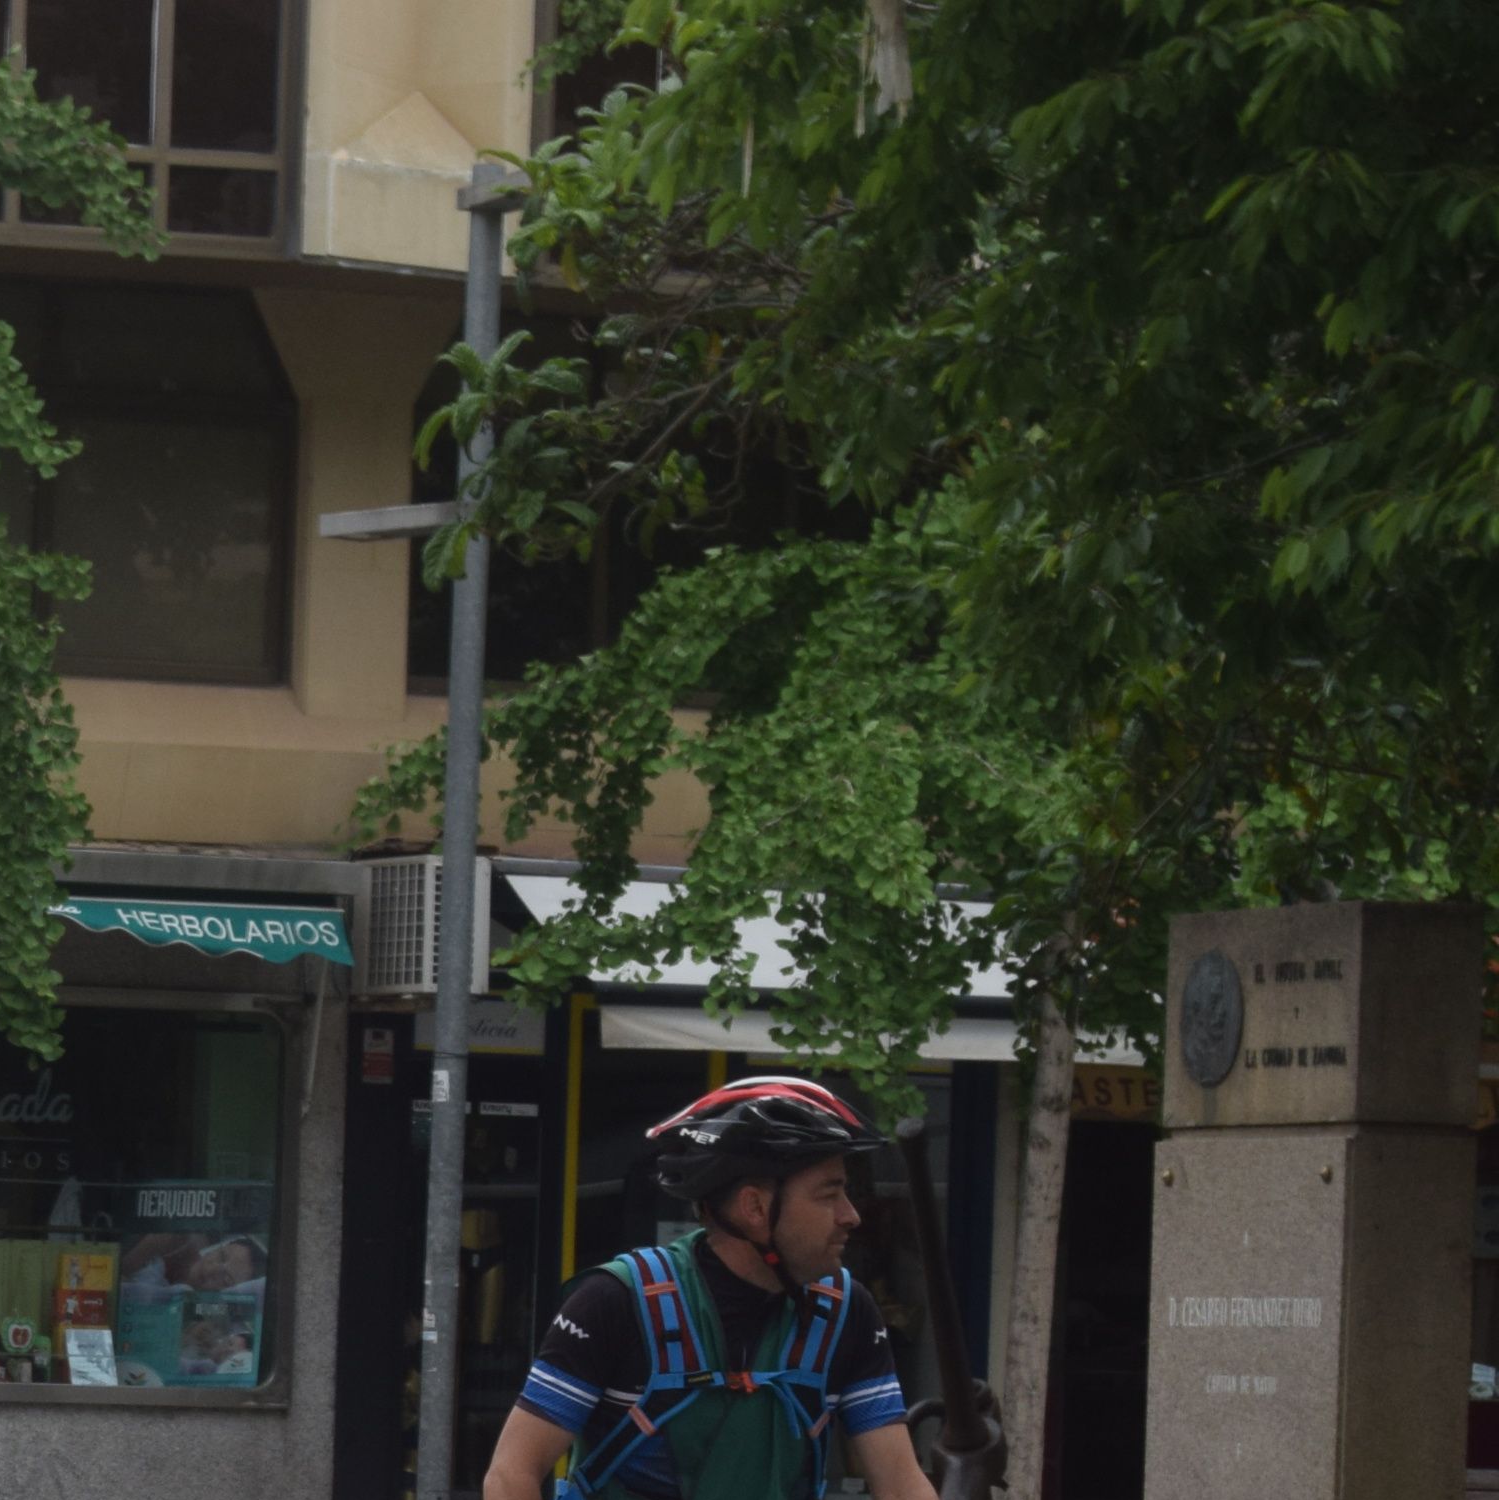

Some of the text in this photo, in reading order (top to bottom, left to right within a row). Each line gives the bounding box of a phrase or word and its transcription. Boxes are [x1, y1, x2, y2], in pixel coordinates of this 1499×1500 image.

[116, 908, 341, 947] HERBOLARIOS
[1073, 1076, 1169, 1106] ASTE
[680, 1127, 721, 1145] MET
[553, 1313, 590, 1340] NW
